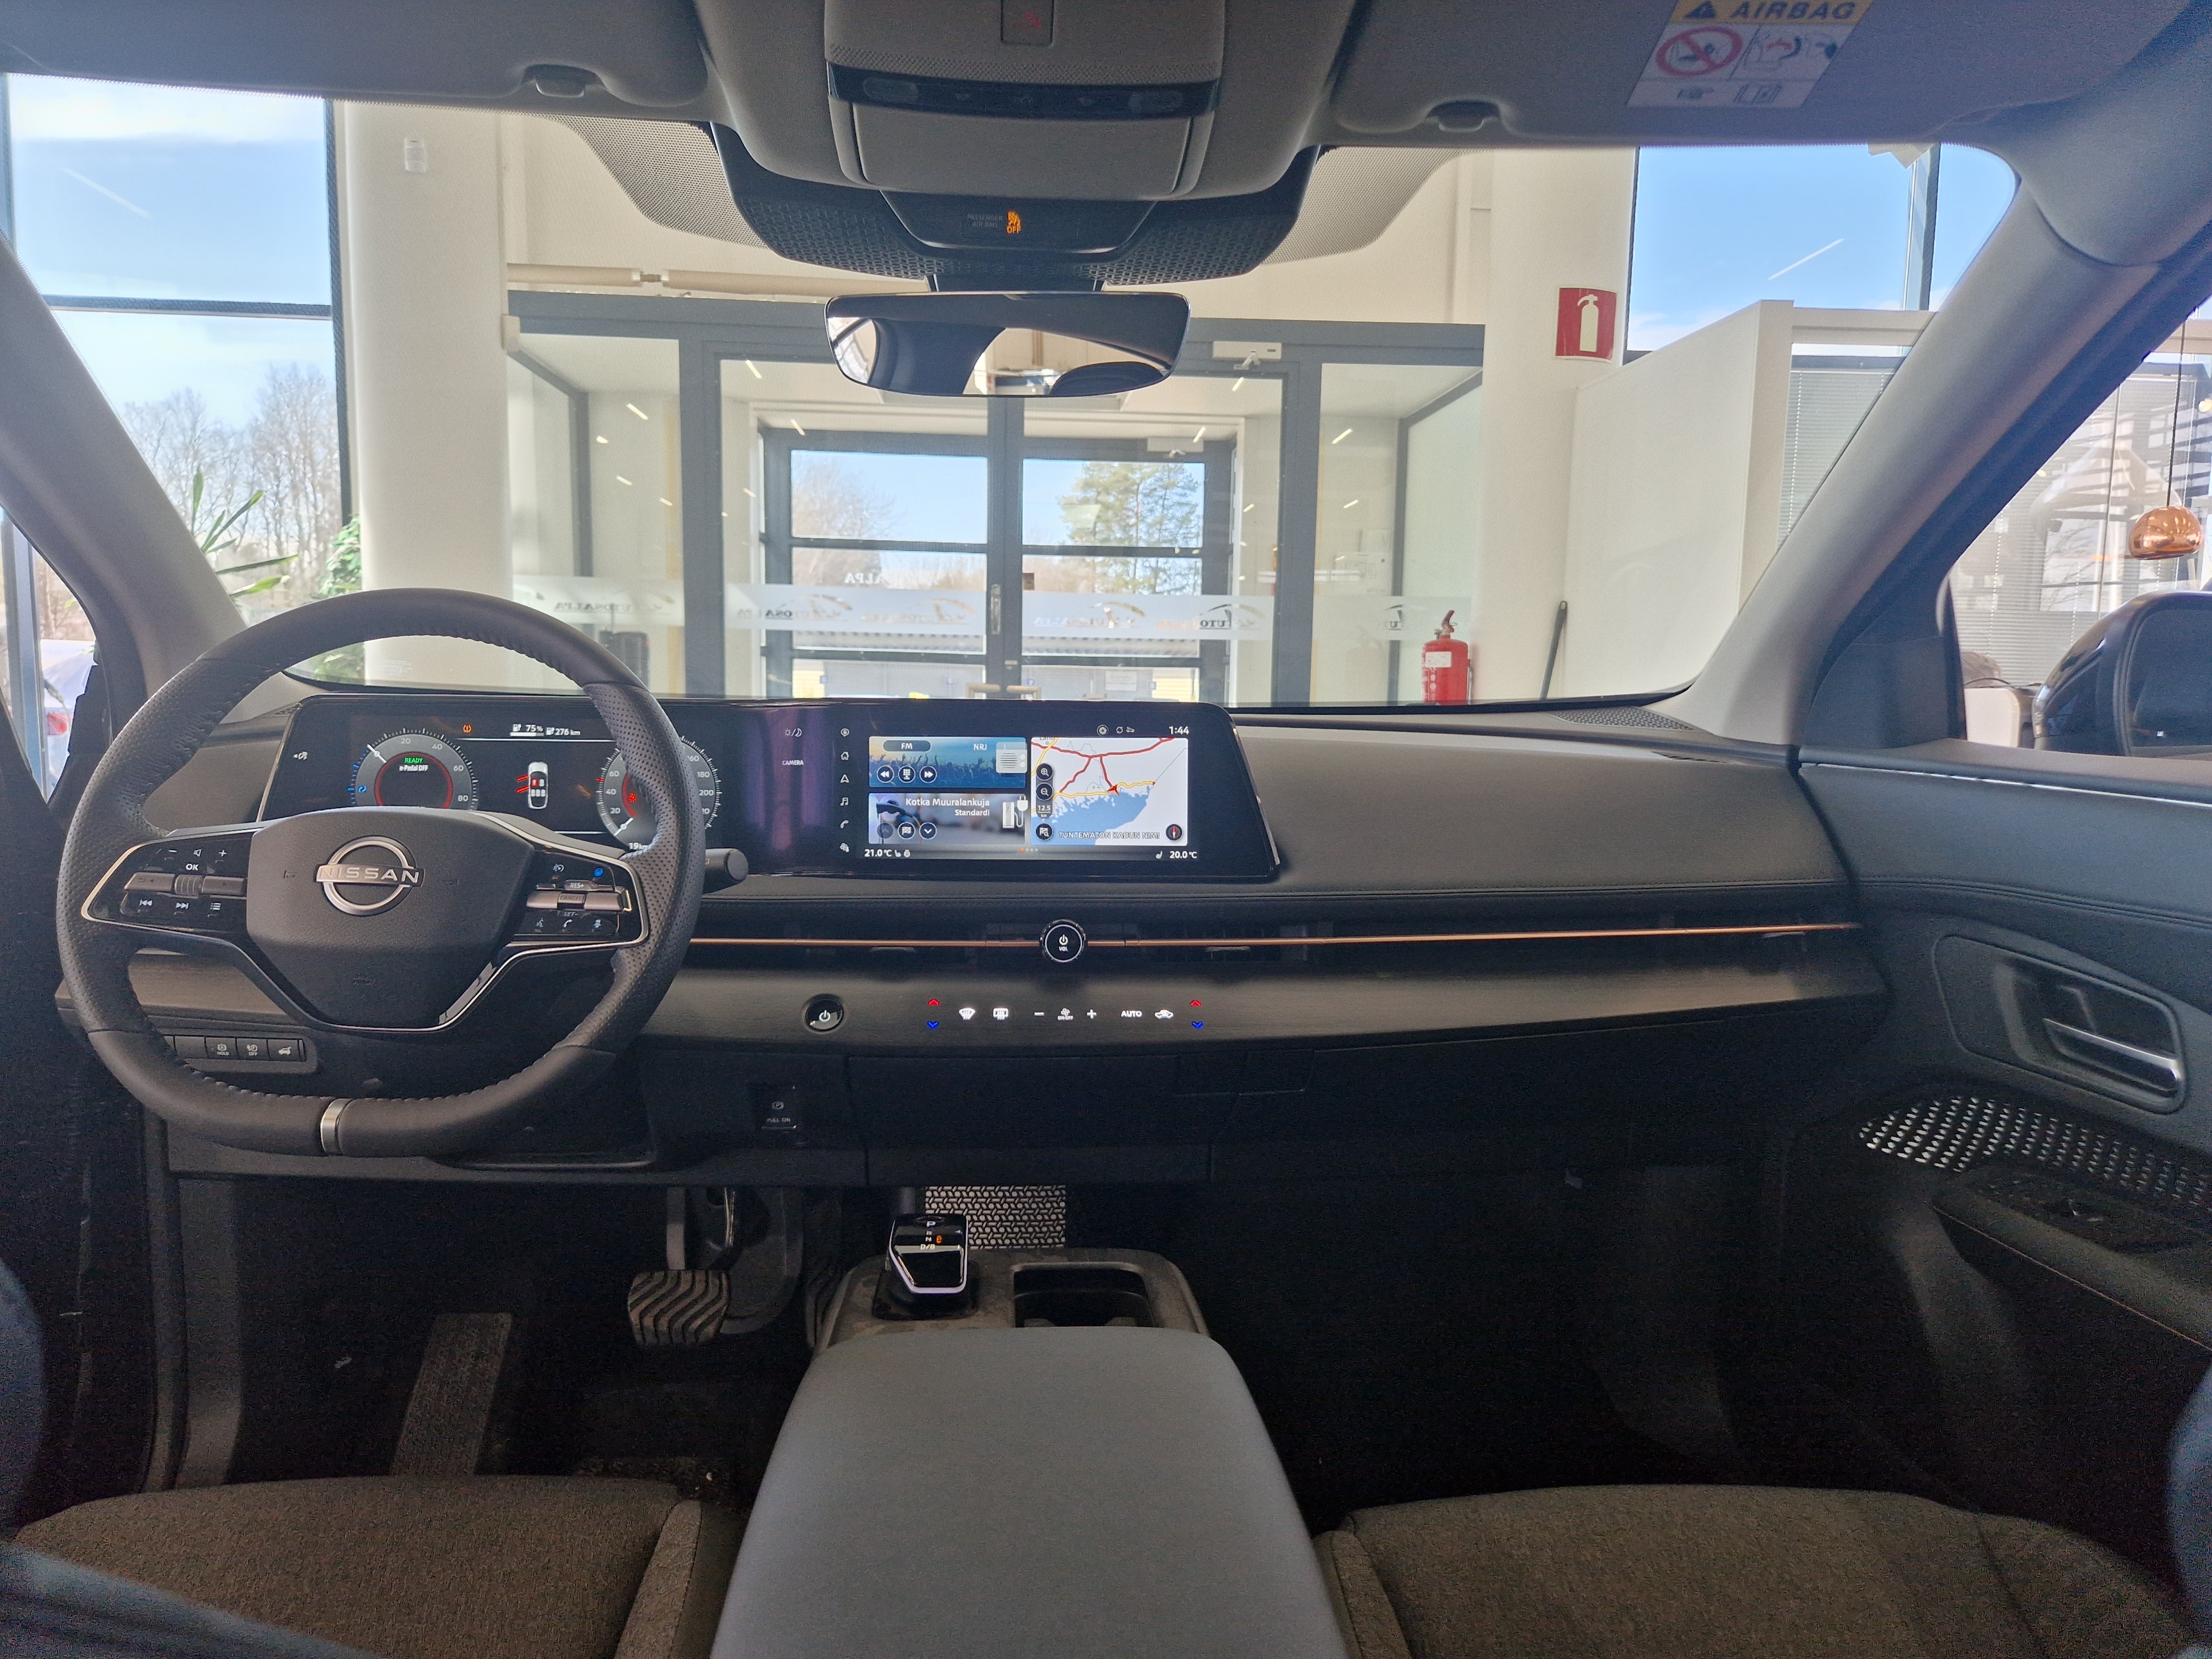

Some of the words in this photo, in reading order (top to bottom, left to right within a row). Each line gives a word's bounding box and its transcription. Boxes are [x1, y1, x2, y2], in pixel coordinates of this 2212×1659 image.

[1729, 1, 1857, 19] AIRBAG
[1006, 225, 1021, 233] OFF
[1169, 726, 1190, 735] 1:44
[906, 798, 931, 806] Kotka
[932, 798, 990, 807] Muuralankuja
[320, 866, 419, 883] NISSAN
